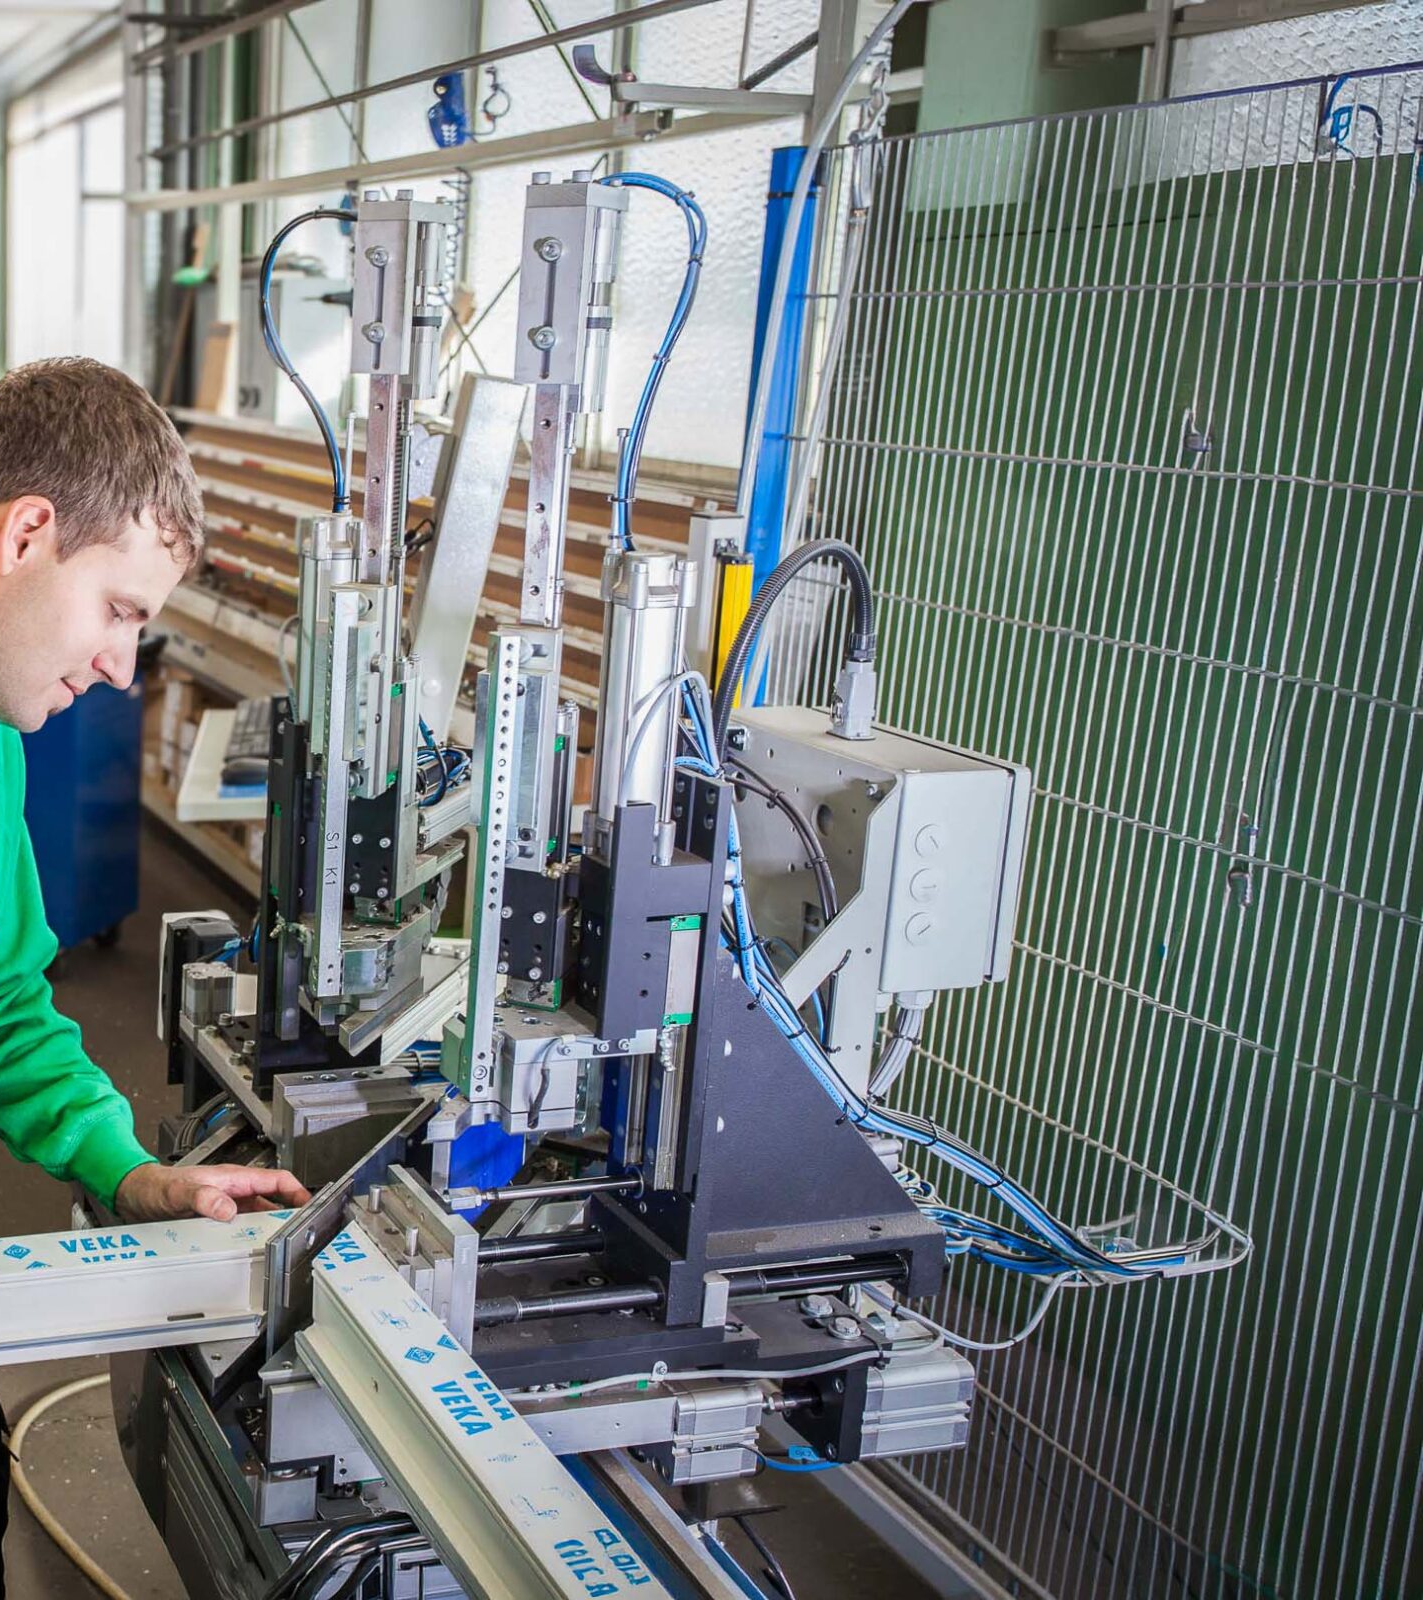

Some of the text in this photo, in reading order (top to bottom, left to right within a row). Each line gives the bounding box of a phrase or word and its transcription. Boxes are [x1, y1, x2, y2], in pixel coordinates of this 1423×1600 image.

[325, 832, 340, 885] S1 K1
[58, 1233, 141, 1253] VEKA
[431, 1380, 493, 1436] VEKA
